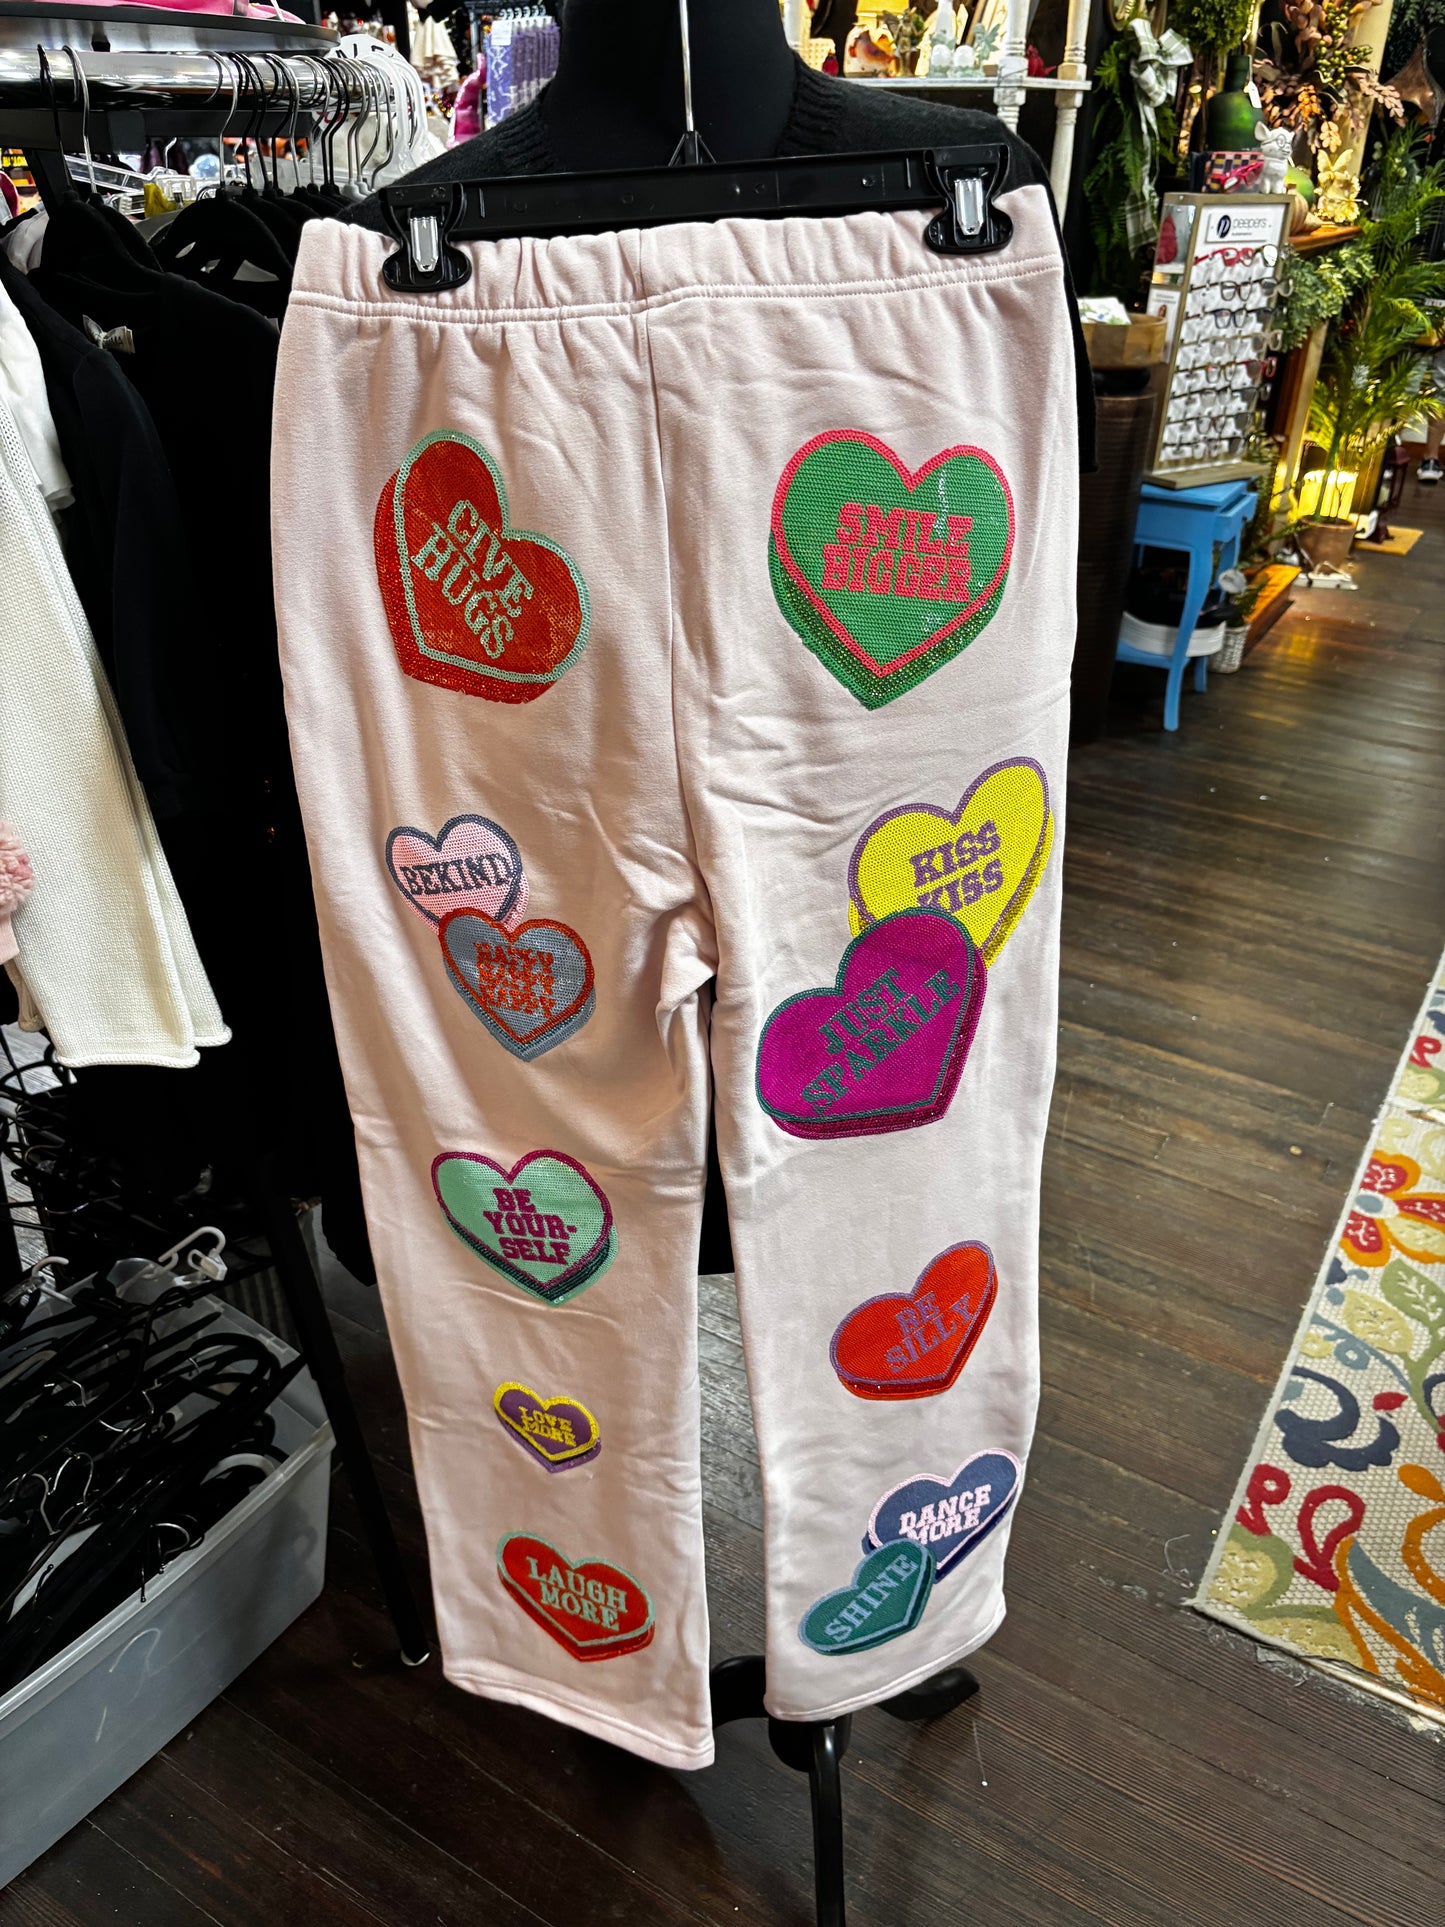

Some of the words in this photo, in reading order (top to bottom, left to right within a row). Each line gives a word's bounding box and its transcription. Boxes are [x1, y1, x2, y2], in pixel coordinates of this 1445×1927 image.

[836, 502, 973, 557] SMILE
[448, 500, 534, 617] GIVE
[821, 543, 972, 602] BIGGER
[410, 522, 514, 658] HUGS
[909, 820, 1001, 888] KISS
[917, 859, 1003, 913] KISS
[818, 967, 908, 1055] JUST
[802, 969, 961, 1115] SPARKLE
[483, 1210, 577, 1240] YOUR-
[492, 1187, 537, 1213] BE
[498, 1237, 570, 1265] SELF
[885, 1293, 974, 1374] SILLY
[894, 1291, 940, 1338] BE
[518, 1406, 572, 1432] LOVE
[899, 1483, 992, 1535] DANCE
[906, 1507, 980, 1545] MORE
[526, 1556, 628, 1614] LAUGH
[540, 1581, 620, 1632] MORE
[825, 1554, 919, 1641] SHINE
